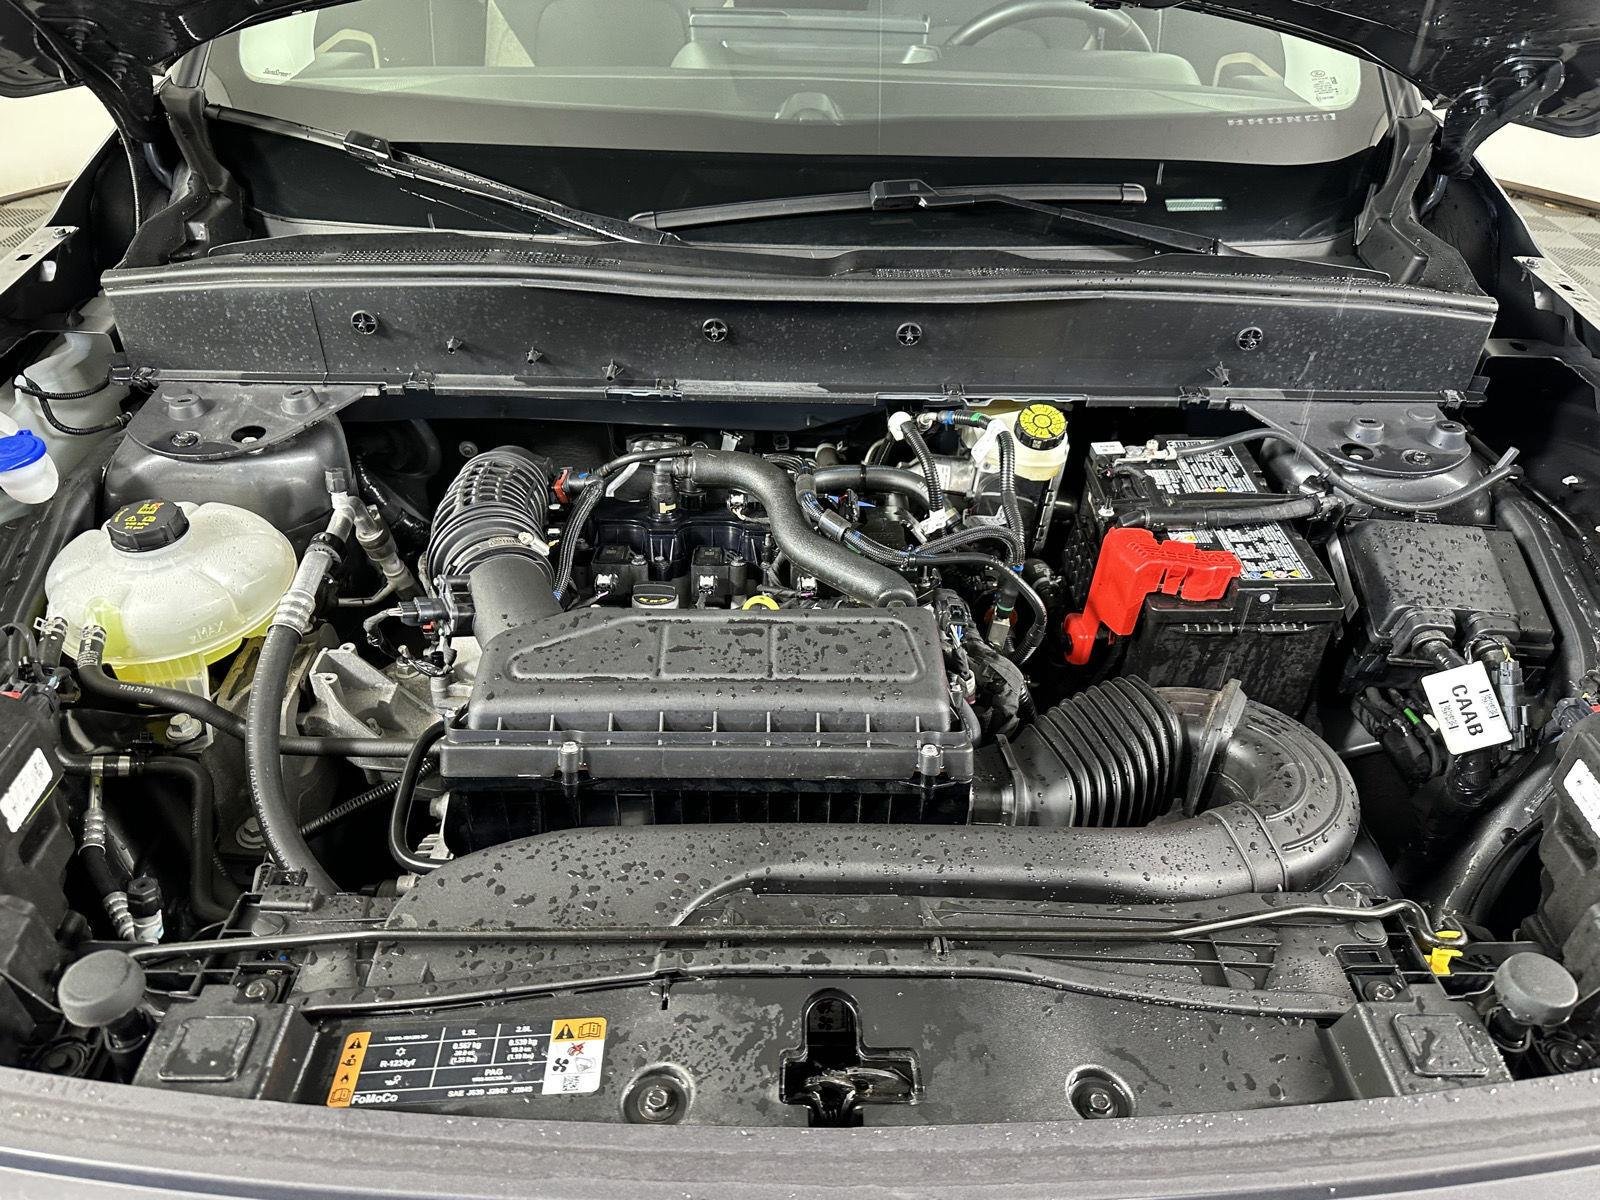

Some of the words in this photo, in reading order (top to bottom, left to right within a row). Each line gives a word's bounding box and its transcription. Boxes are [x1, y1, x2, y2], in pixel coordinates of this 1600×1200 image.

[1451, 684, 1484, 737] CAAB
[249, 768, 263, 806] GALAXY
[379, 1058, 417, 1068] R-1234yf
[484, 1068, 504, 1076] PAG
[351, 1093, 398, 1105] FoMoCo
[447, 1089, 465, 1098] SAE
